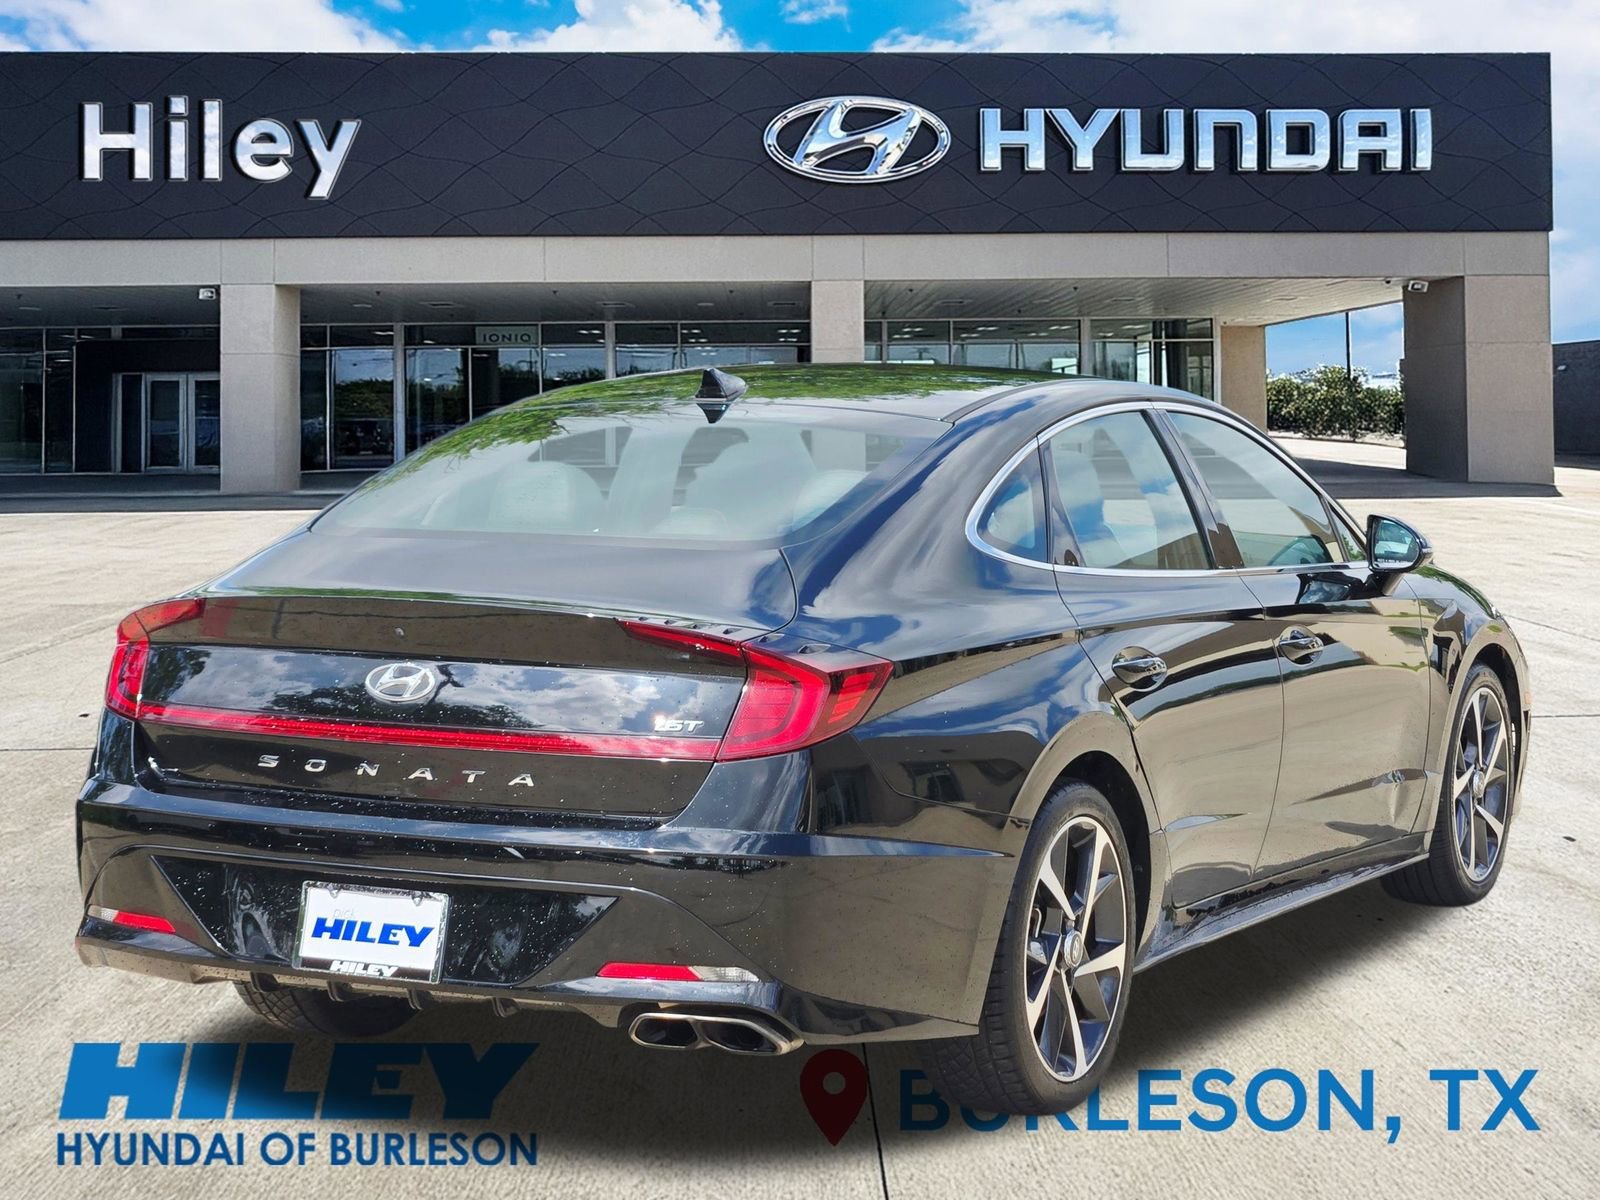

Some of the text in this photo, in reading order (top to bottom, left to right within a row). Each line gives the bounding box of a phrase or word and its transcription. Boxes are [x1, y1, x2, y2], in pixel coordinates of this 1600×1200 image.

[80, 95, 362, 200] Hiley
[979, 107, 1433, 173] HYUNDAI
[257, 754, 535, 787] SONATA
[311, 917, 435, 947] HILEY
[329, 960, 399, 977] HILEY
